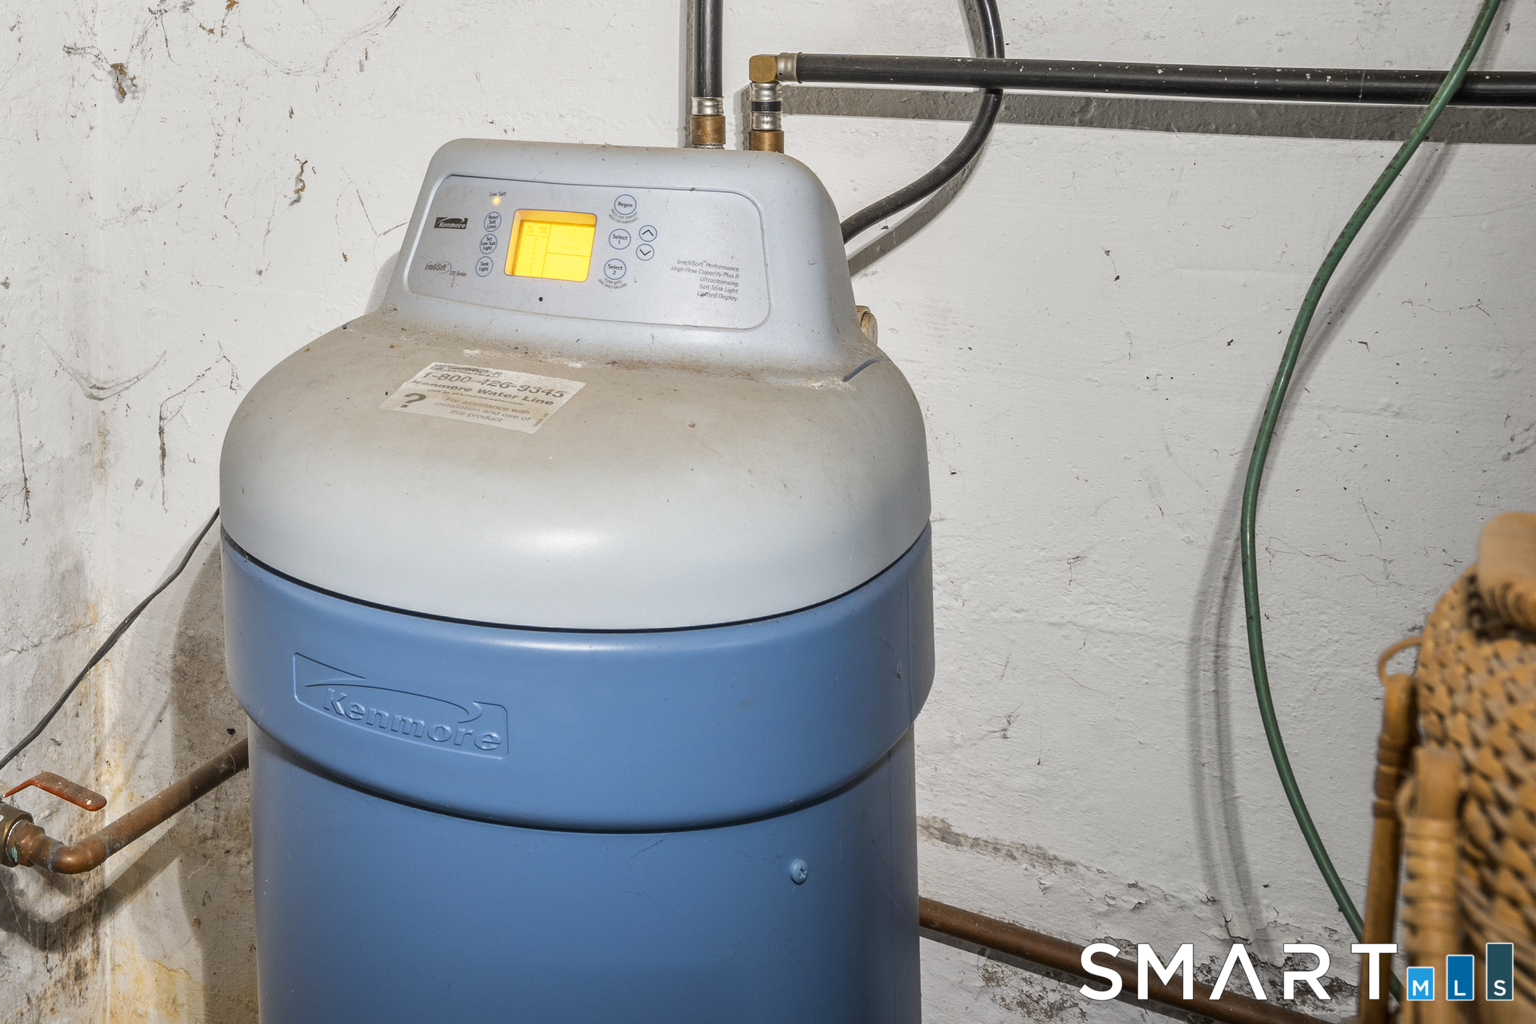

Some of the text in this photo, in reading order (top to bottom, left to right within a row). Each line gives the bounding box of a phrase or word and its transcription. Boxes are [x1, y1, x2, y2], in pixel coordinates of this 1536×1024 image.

[698, 268, 722, 277] Capacity
[723, 271, 734, 279] Plus
[705, 262, 740, 272] Performance
[700, 276, 739, 287] Ultracleansing
[711, 284, 723, 292] Tank
[718, 293, 738, 302] Display
[477, 388, 520, 400] Water
[522, 395, 554, 406] Line
[433, 401, 482, 414] installation
[483, 408, 501, 417] and
[501, 412, 520, 420] use
[444, 396, 531, 416] For assistance with
[449, 409, 503, 424] this product
[323, 688, 502, 751] Kenmore
